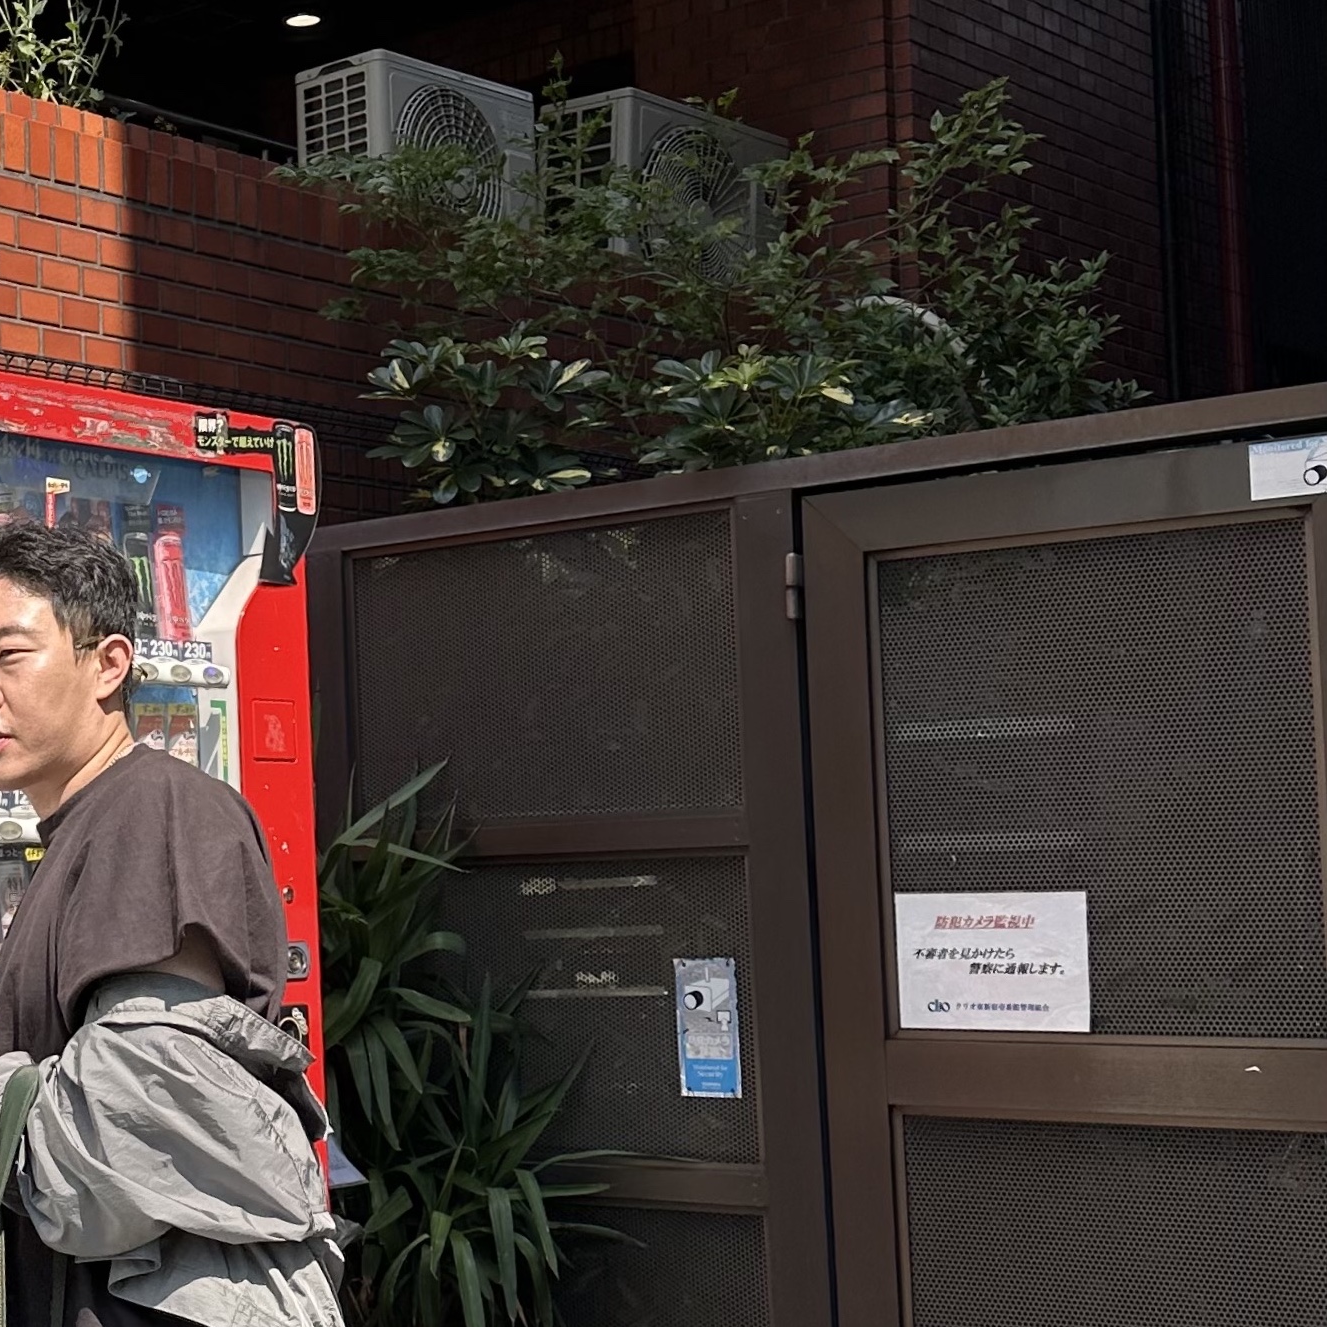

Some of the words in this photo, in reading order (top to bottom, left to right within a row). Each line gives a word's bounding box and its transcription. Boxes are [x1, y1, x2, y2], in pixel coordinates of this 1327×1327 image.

[934, 914, 1035, 929] 防犯カメラ監視中
[913, 947, 1016, 960] 不審者を見かけたら
[968, 962, 1066, 975] 警察に通報します。
